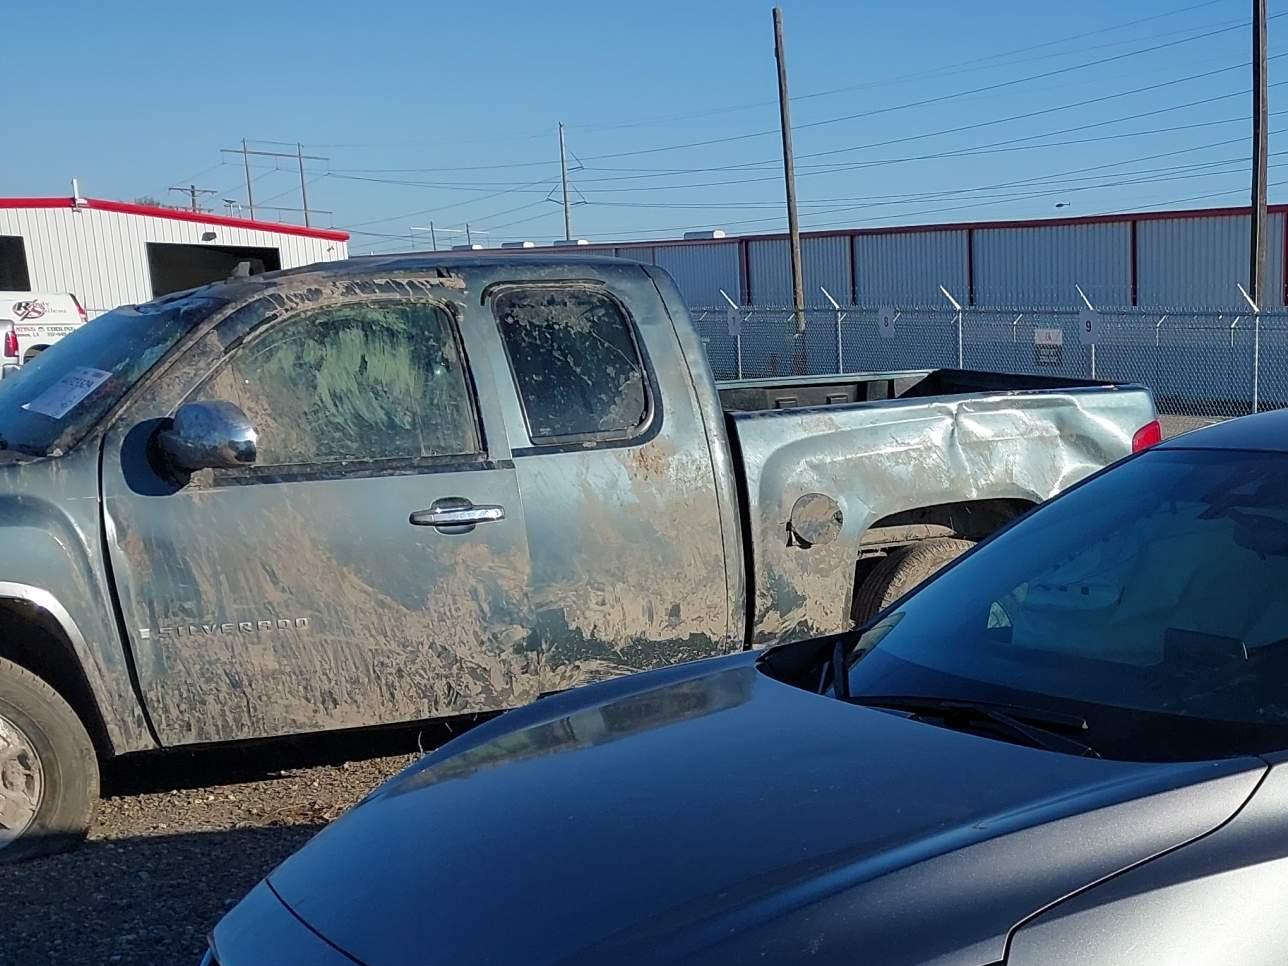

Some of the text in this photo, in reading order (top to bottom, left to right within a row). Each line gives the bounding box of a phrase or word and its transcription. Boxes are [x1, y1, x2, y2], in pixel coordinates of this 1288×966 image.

[883, 316, 889, 328] 8
[1085, 320, 1092, 332] 9
[159, 617, 309, 635] SILVERADO
